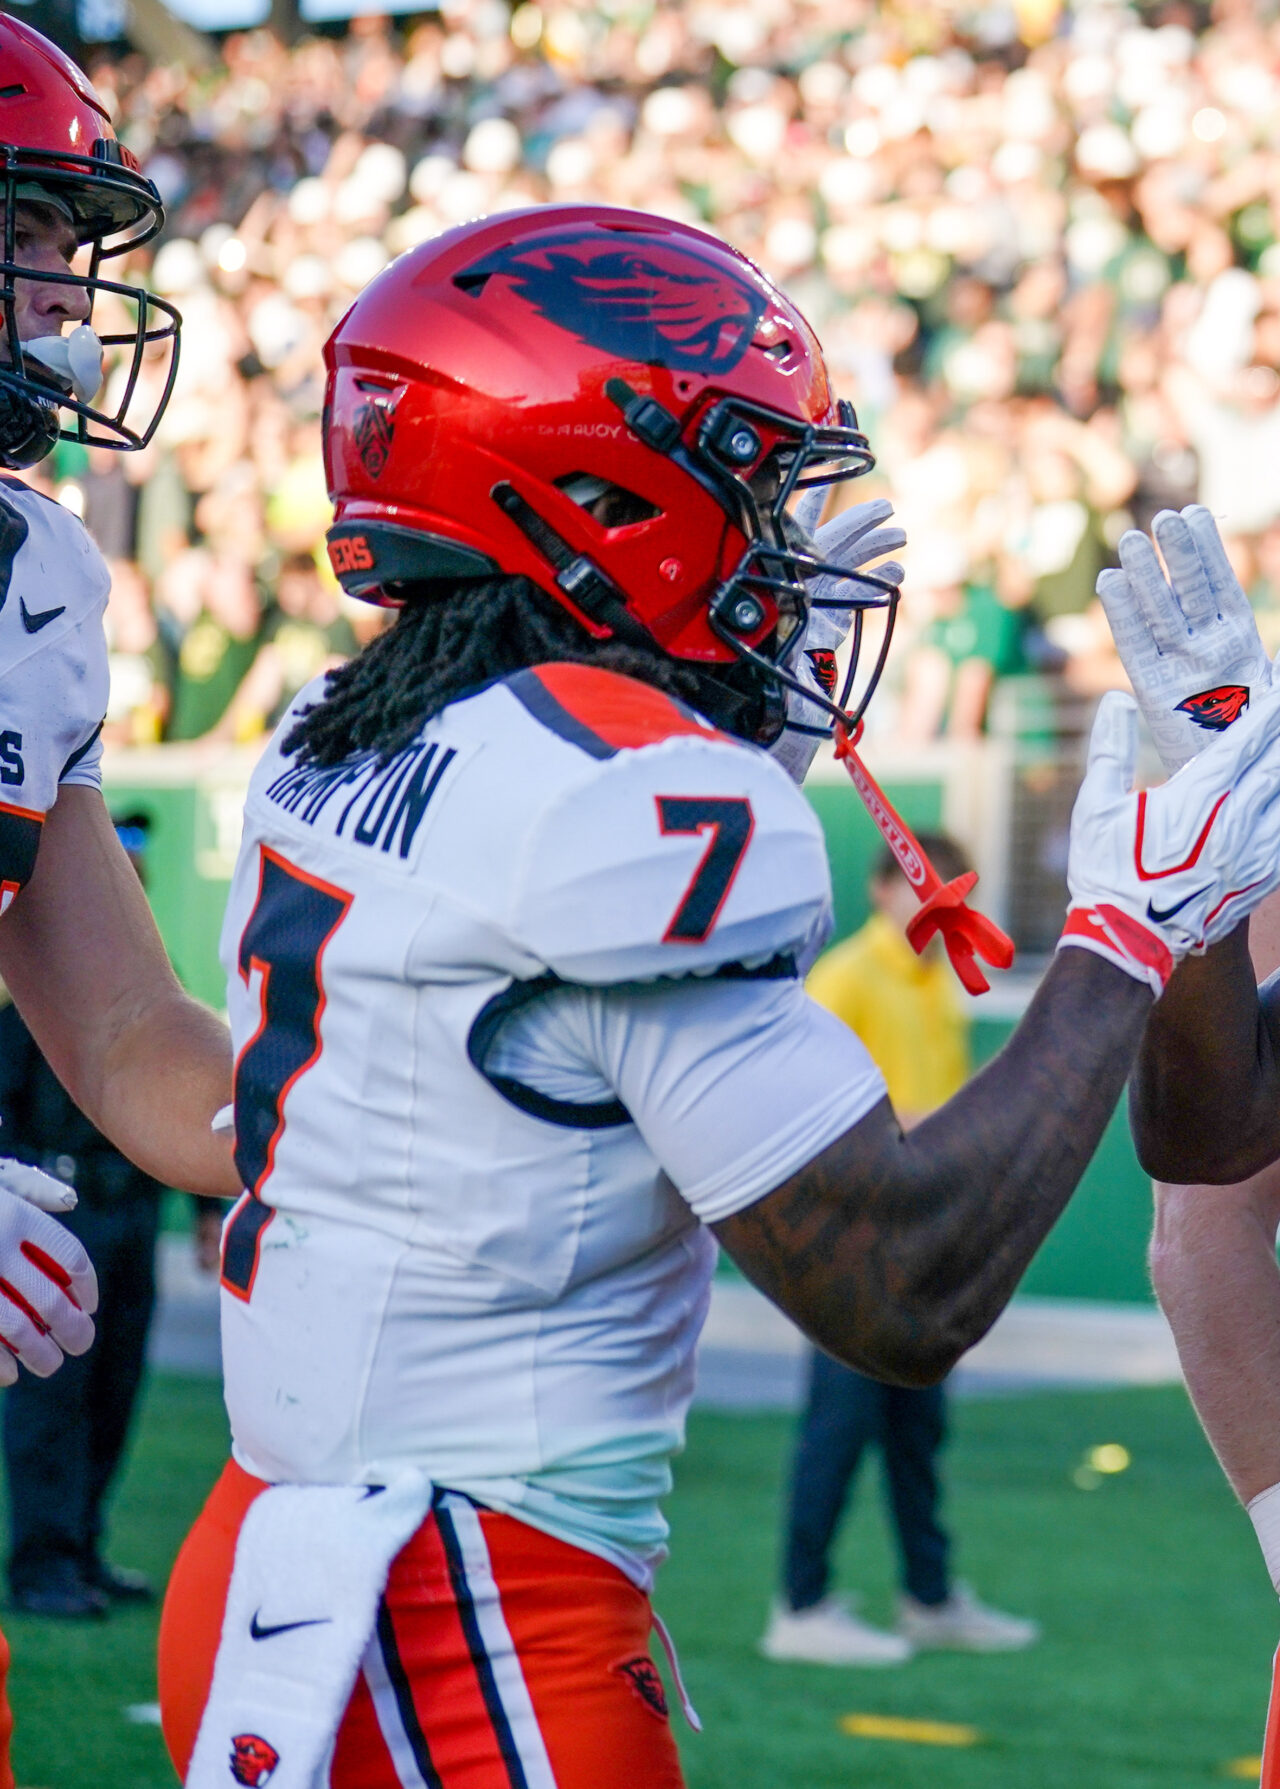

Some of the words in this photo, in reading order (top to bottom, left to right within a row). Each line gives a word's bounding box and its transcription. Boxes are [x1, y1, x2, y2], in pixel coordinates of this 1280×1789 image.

[1142, 637, 1246, 688] BEAVERS
[654, 795, 756, 944] 7
[219, 842, 355, 1304] 7
